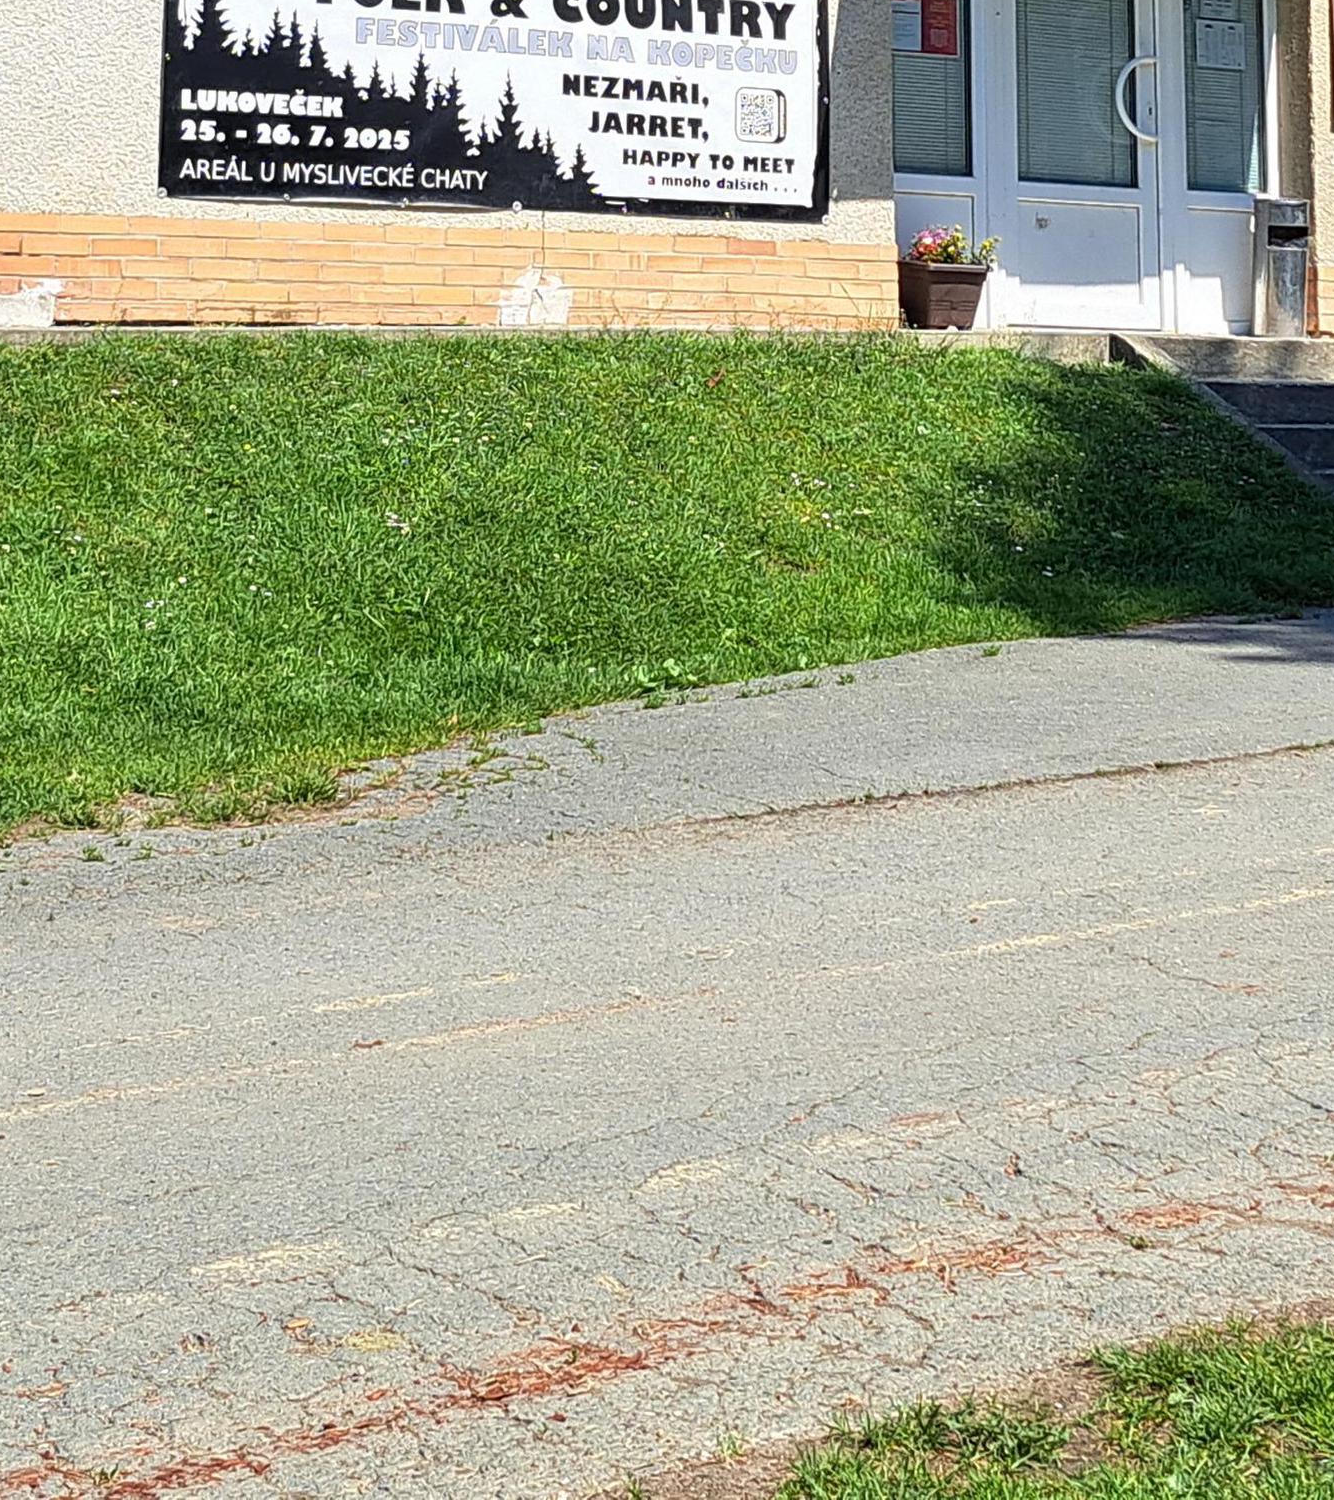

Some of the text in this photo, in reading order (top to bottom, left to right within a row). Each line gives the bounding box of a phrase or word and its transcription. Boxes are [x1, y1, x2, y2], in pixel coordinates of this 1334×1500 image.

[355, 16, 799, 75] FESTIVÁLEK NA KOPEČKU
[180, 88, 344, 118] LUKOVEČEK
[562, 74, 710, 109] NEZMAŘI,
[180, 119, 226, 142] 25.
[256, 123, 300, 146] 26.
[308, 125, 334, 147] 7.
[344, 127, 410, 150] 2025
[588, 111, 710, 143] JARRET,
[179, 155, 488, 190] AREÁL U MYSLIVECKÉ CHATY
[622, 148, 795, 174] HAPPY TO MEET
[648, 176, 656, 186] a
[661, 176, 710, 188] mnoho
